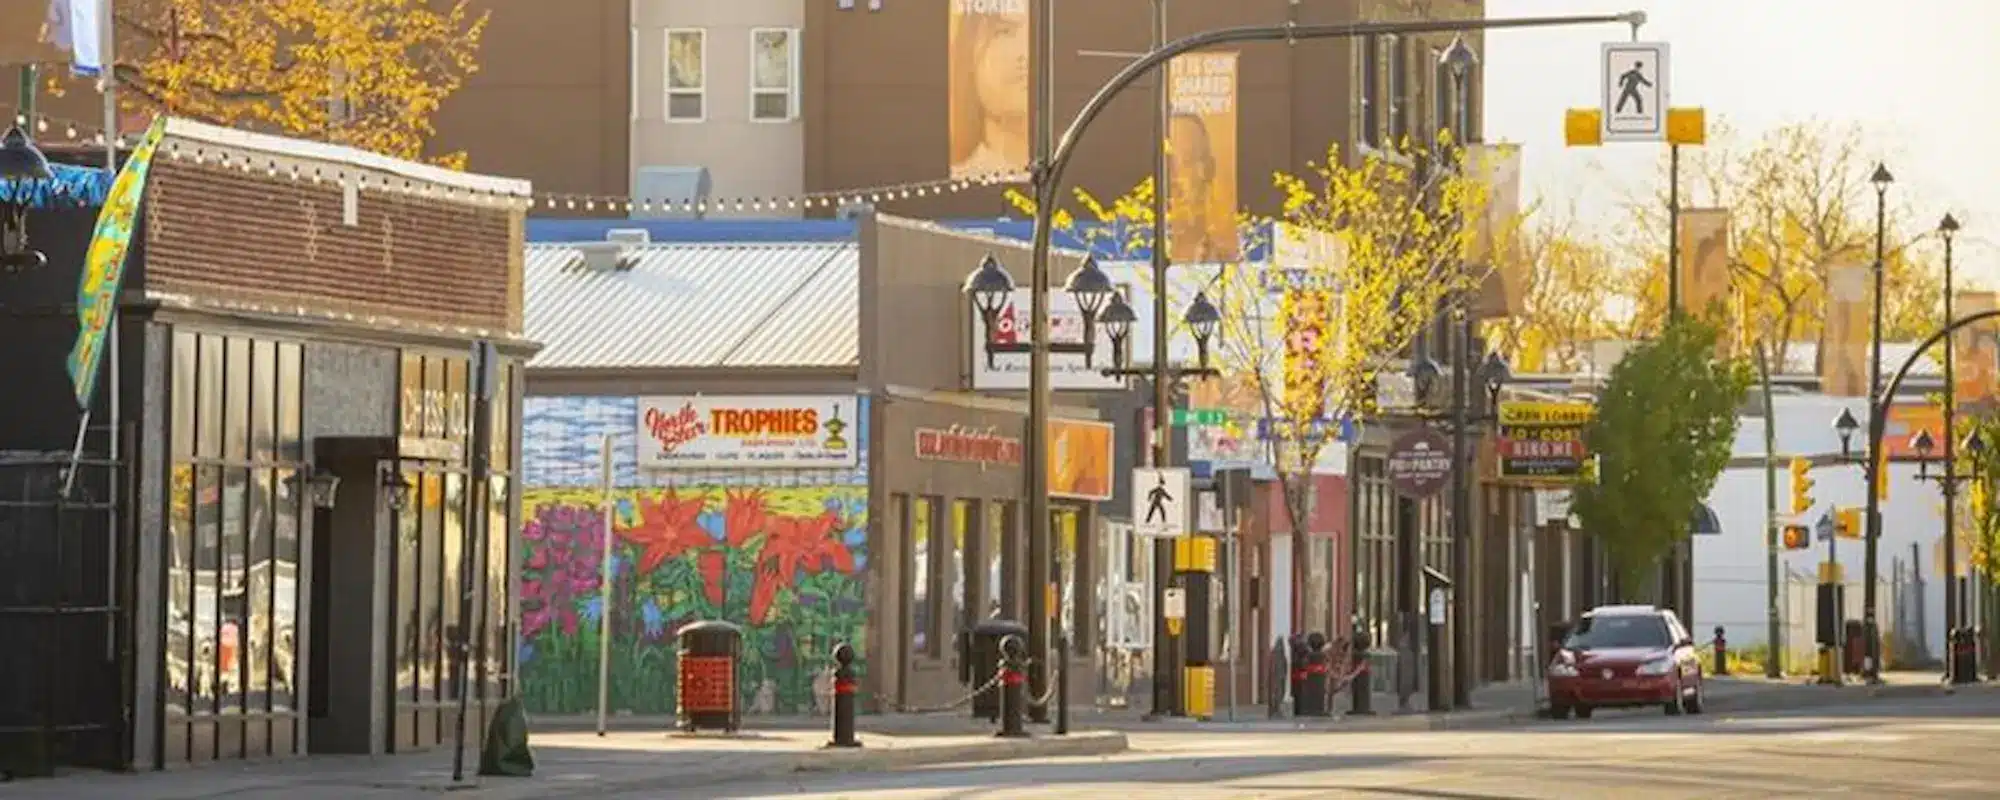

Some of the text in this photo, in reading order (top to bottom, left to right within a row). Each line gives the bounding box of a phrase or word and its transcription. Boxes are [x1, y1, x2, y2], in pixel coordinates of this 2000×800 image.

[1175, 76, 1230, 93] SHARED
[1169, 96, 1232, 113] HISTORY
[645, 402, 698, 437] North
[711, 408, 818, 436] TROPHIES
